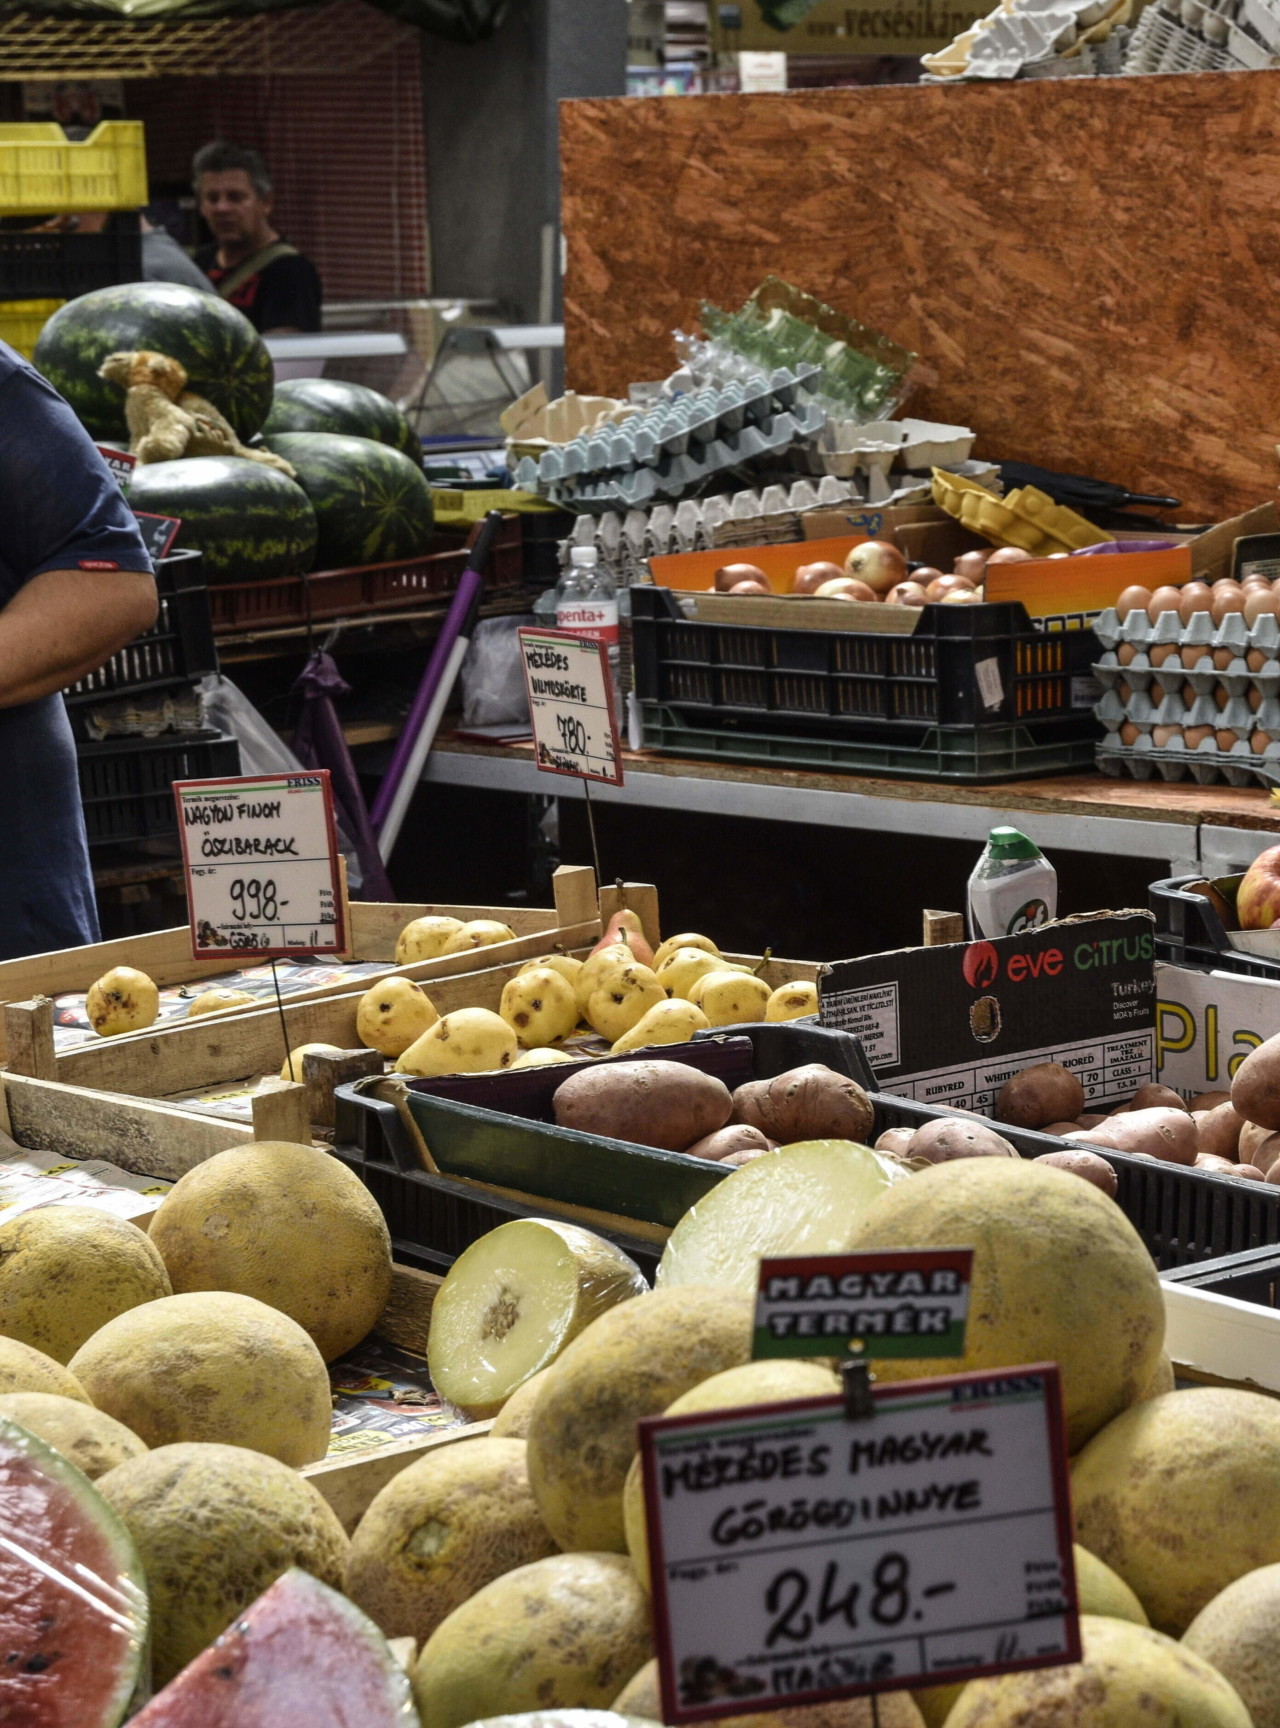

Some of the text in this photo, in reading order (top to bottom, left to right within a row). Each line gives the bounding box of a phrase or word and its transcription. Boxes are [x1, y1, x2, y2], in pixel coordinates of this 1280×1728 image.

[287, 777, 321, 788] FRISS
[184, 801, 281, 826] NAGYON FINOM
[1006, 947, 1064, 982] eve
[1110, 977, 1156, 998] Turkey
[1113, 1000, 1139, 1010] Discover
[1133, 1007, 1150, 1017] Fruits
[1107, 1039, 1148, 1053] TREATMENT
[1062, 1055, 1094, 1069] RIORED
[1110, 1053, 1145, 1065] IMAZALIL
[1086, 1072, 1099, 1083] 70
[1112, 1066, 1133, 1078] CLASS
[925, 1081, 965, 1097] RUBYRED
[1088, 1087, 1095, 1096] 9
[954, 1099, 966, 1109] 40
[976, 1095, 988, 1104] 45
[767, 1270, 961, 1299] MAGYAR
[769, 1303, 952, 1338] TERMÉK
[848, 1429, 993, 1475] MAGYAR
